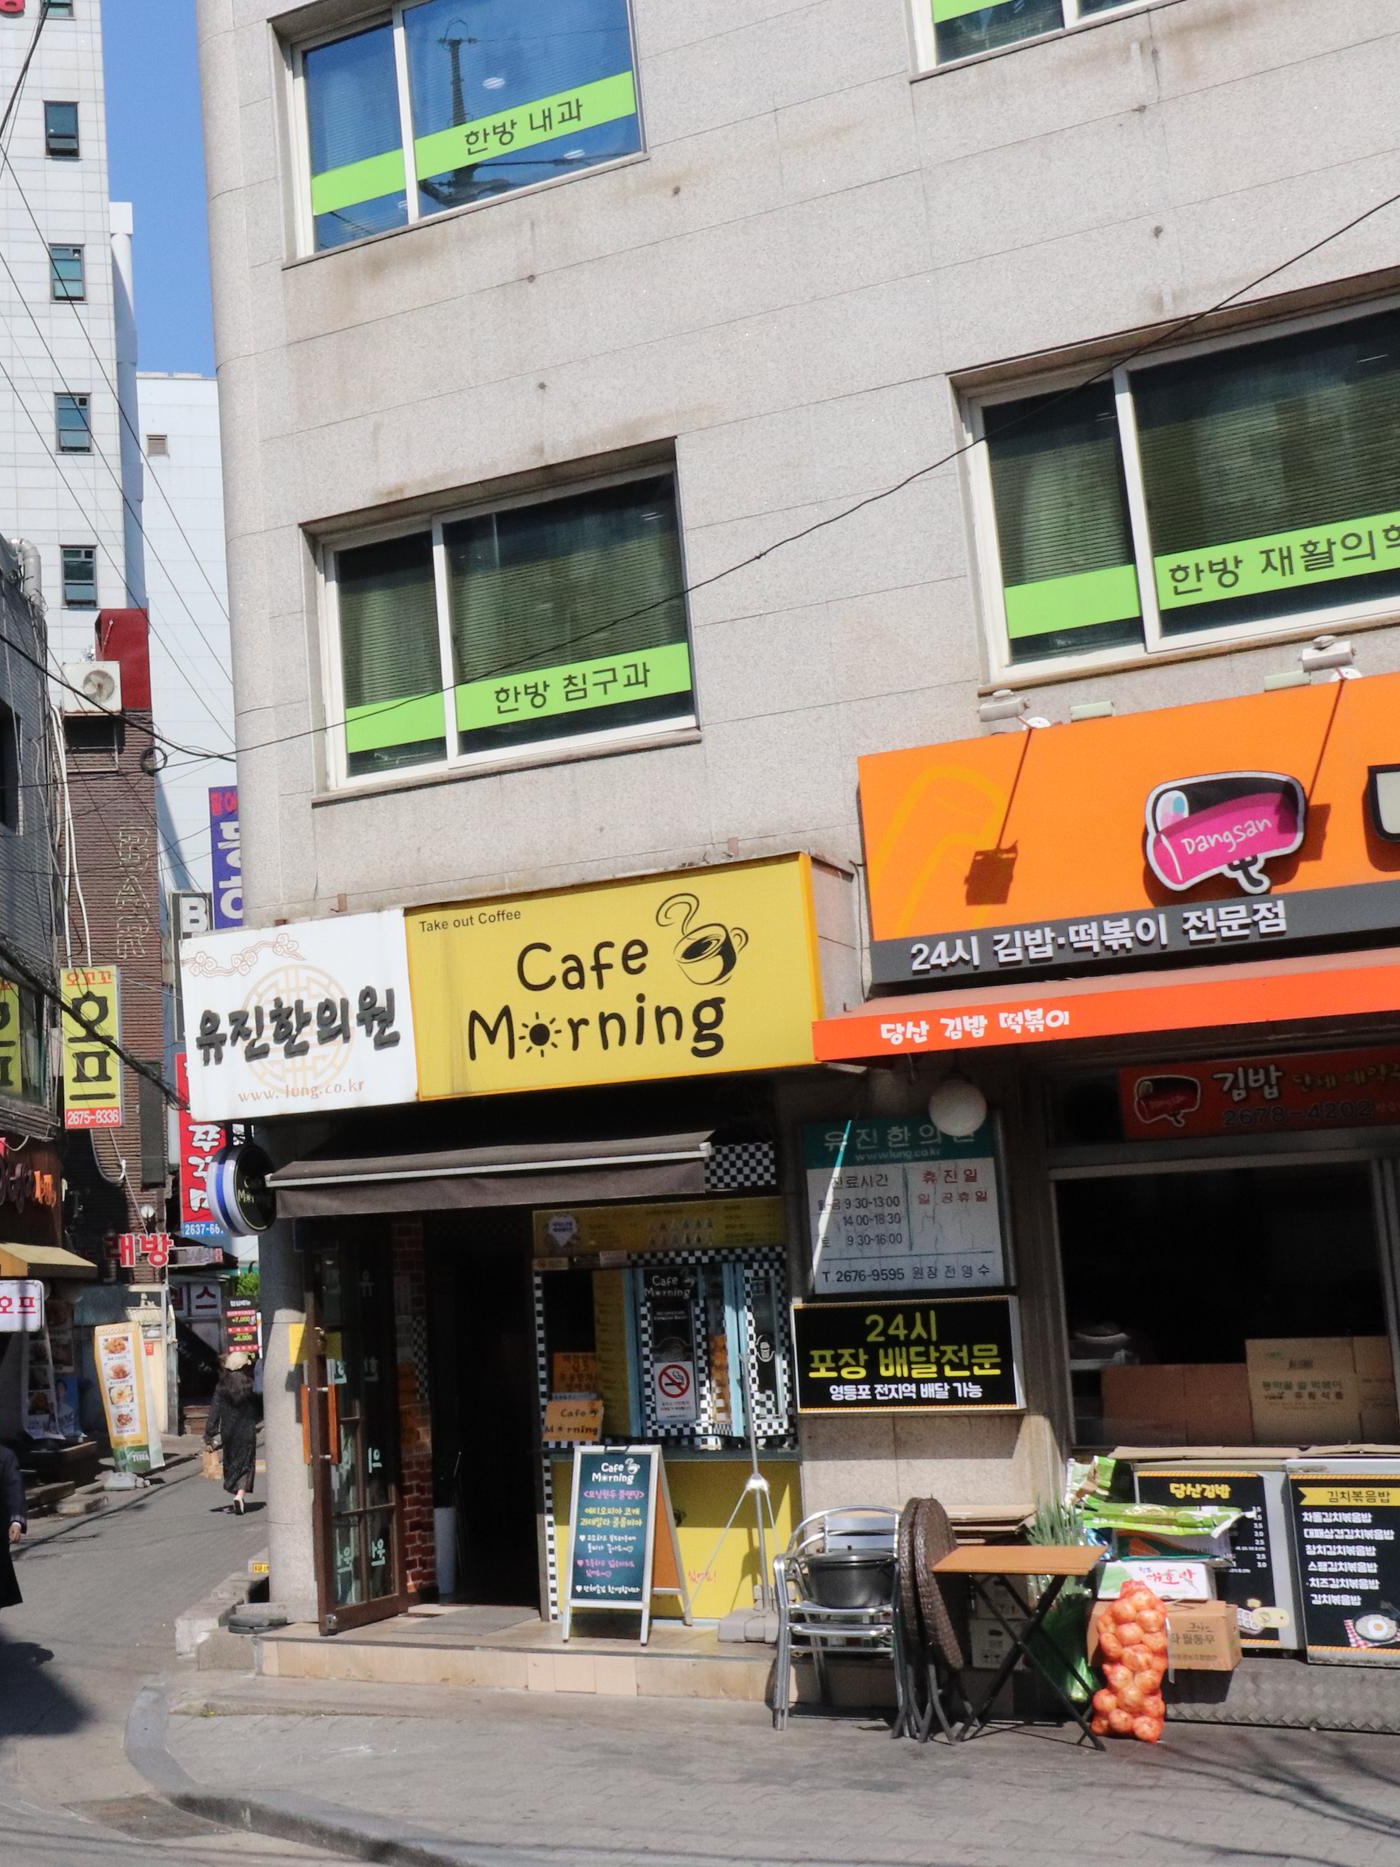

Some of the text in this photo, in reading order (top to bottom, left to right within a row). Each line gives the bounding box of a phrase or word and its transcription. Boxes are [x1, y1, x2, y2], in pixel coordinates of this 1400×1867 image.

[465, 98, 585, 157] 한방 내과
[1168, 554, 1243, 596] 한방
[494, 661, 651, 715] 한방 침구과
[1180, 815, 1272, 857] Dangsan
[418, 908, 522, 933] Take out Coffee
[911, 935, 981, 973] 24시
[1181, 899, 1288, 943] 전문점
[517, 937, 650, 991] Cafe
[196, 985, 401, 1066] 유진한의원
[880, 1008, 1071, 1045] 당산 김밥 떡볶이
[1213, 1064, 1284, 1102] 김밥
[67, 1110, 119, 1126] 2675-8336
[922, 1167, 979, 1185] 휴진일
[651, 1274, 679, 1287] Cafe
[864, 1310, 938, 1342] 24시
[808, 1343, 1002, 1379] 포장 배달전문
[829, 1381, 983, 1401] 영등포 전지역 배달 가능
[560, 1407, 588, 1418] Cafe
[601, 1462, 624, 1473] Cafe
[1169, 1482, 1232, 1499] 당산김밥
[1327, 1490, 1390, 1503] 김치볶음밥
[1302, 1511, 1373, 1524] 차돌김치볶음밥
[1305, 1544, 1377, 1557] 참치김치볶음밥
[1307, 1561, 1378, 1573] 스팸김치볶음밥
[1310, 1594, 1362, 1607] 김치볶음밥
